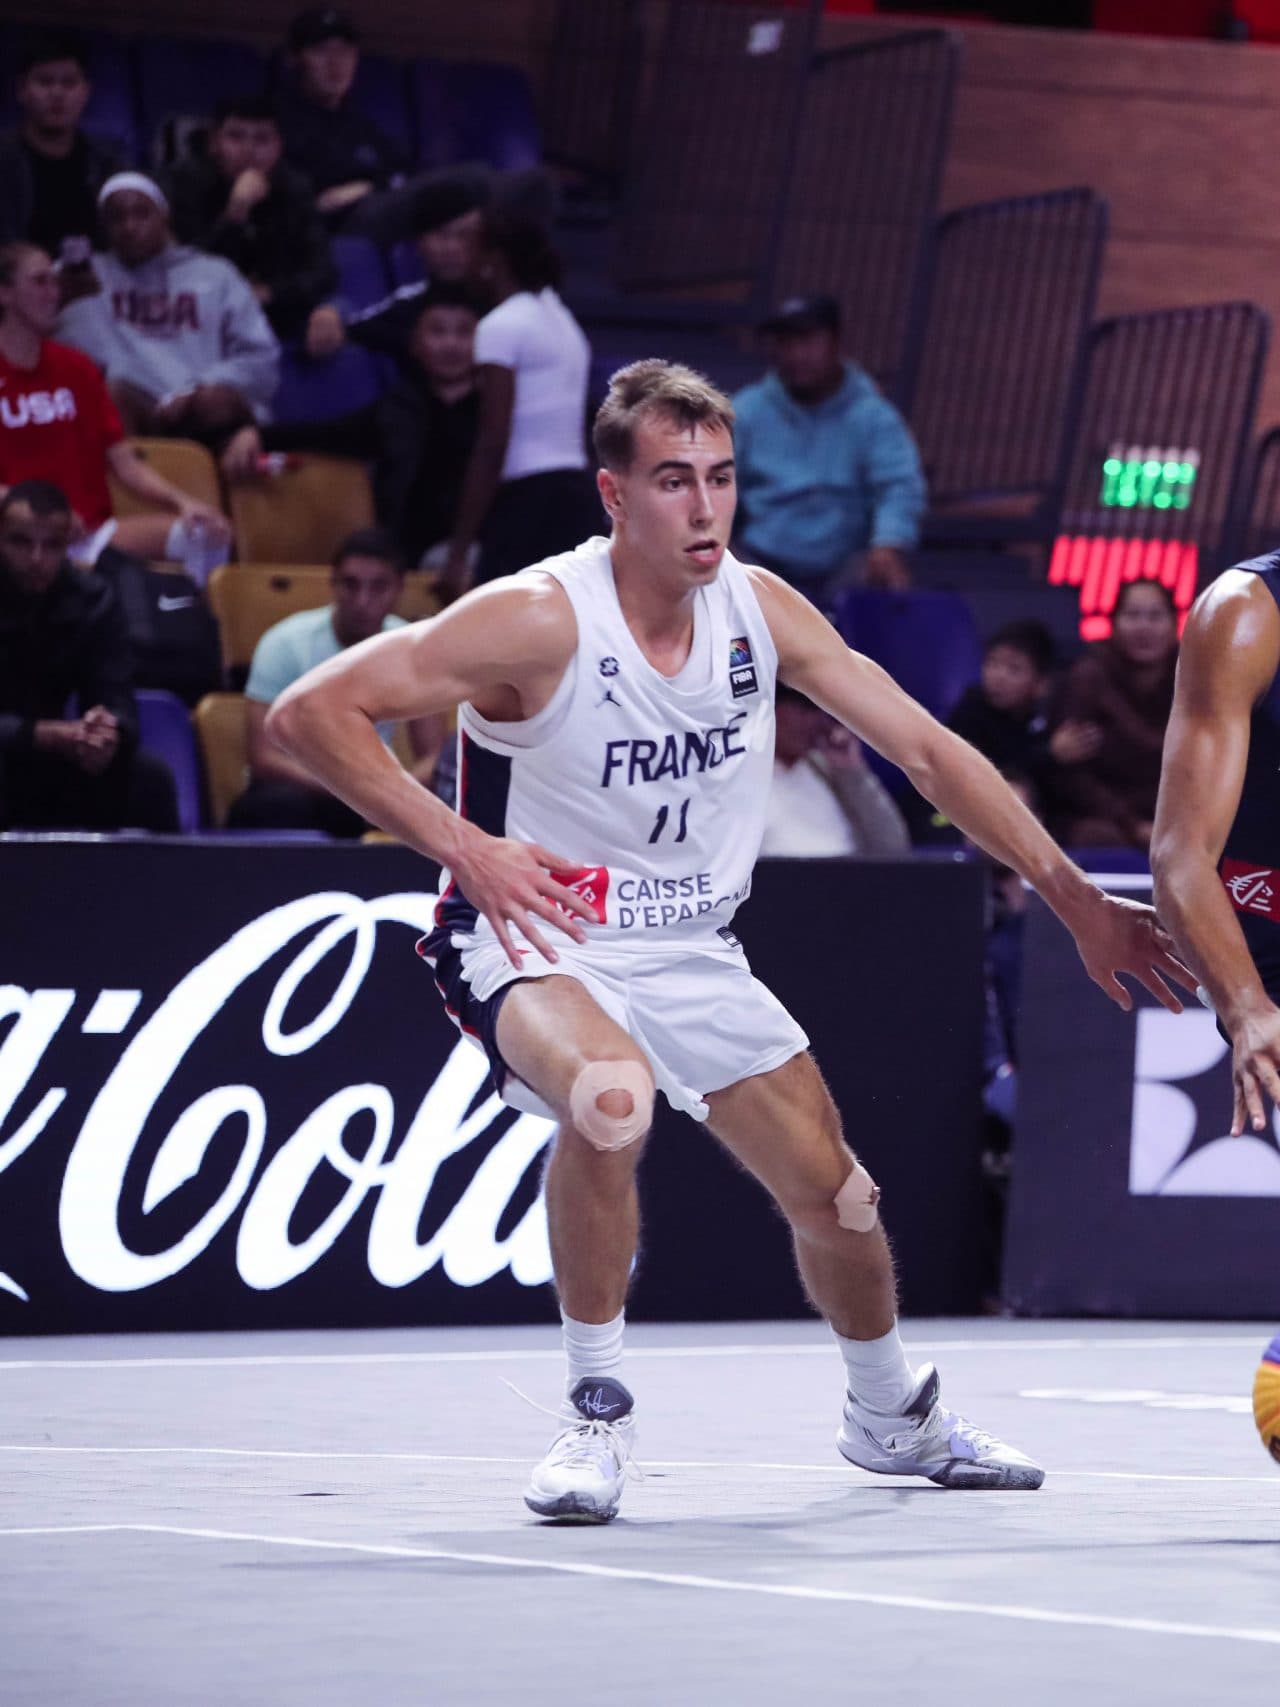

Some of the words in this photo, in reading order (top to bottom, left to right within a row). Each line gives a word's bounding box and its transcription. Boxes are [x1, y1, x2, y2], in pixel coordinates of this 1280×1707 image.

[1, 388, 76, 428] USA
[732, 670, 753, 684] FIBA
[601, 712, 747, 787] FRANCE
[648, 798, 690, 844] 11
[617, 873, 713, 902] CAISSE
